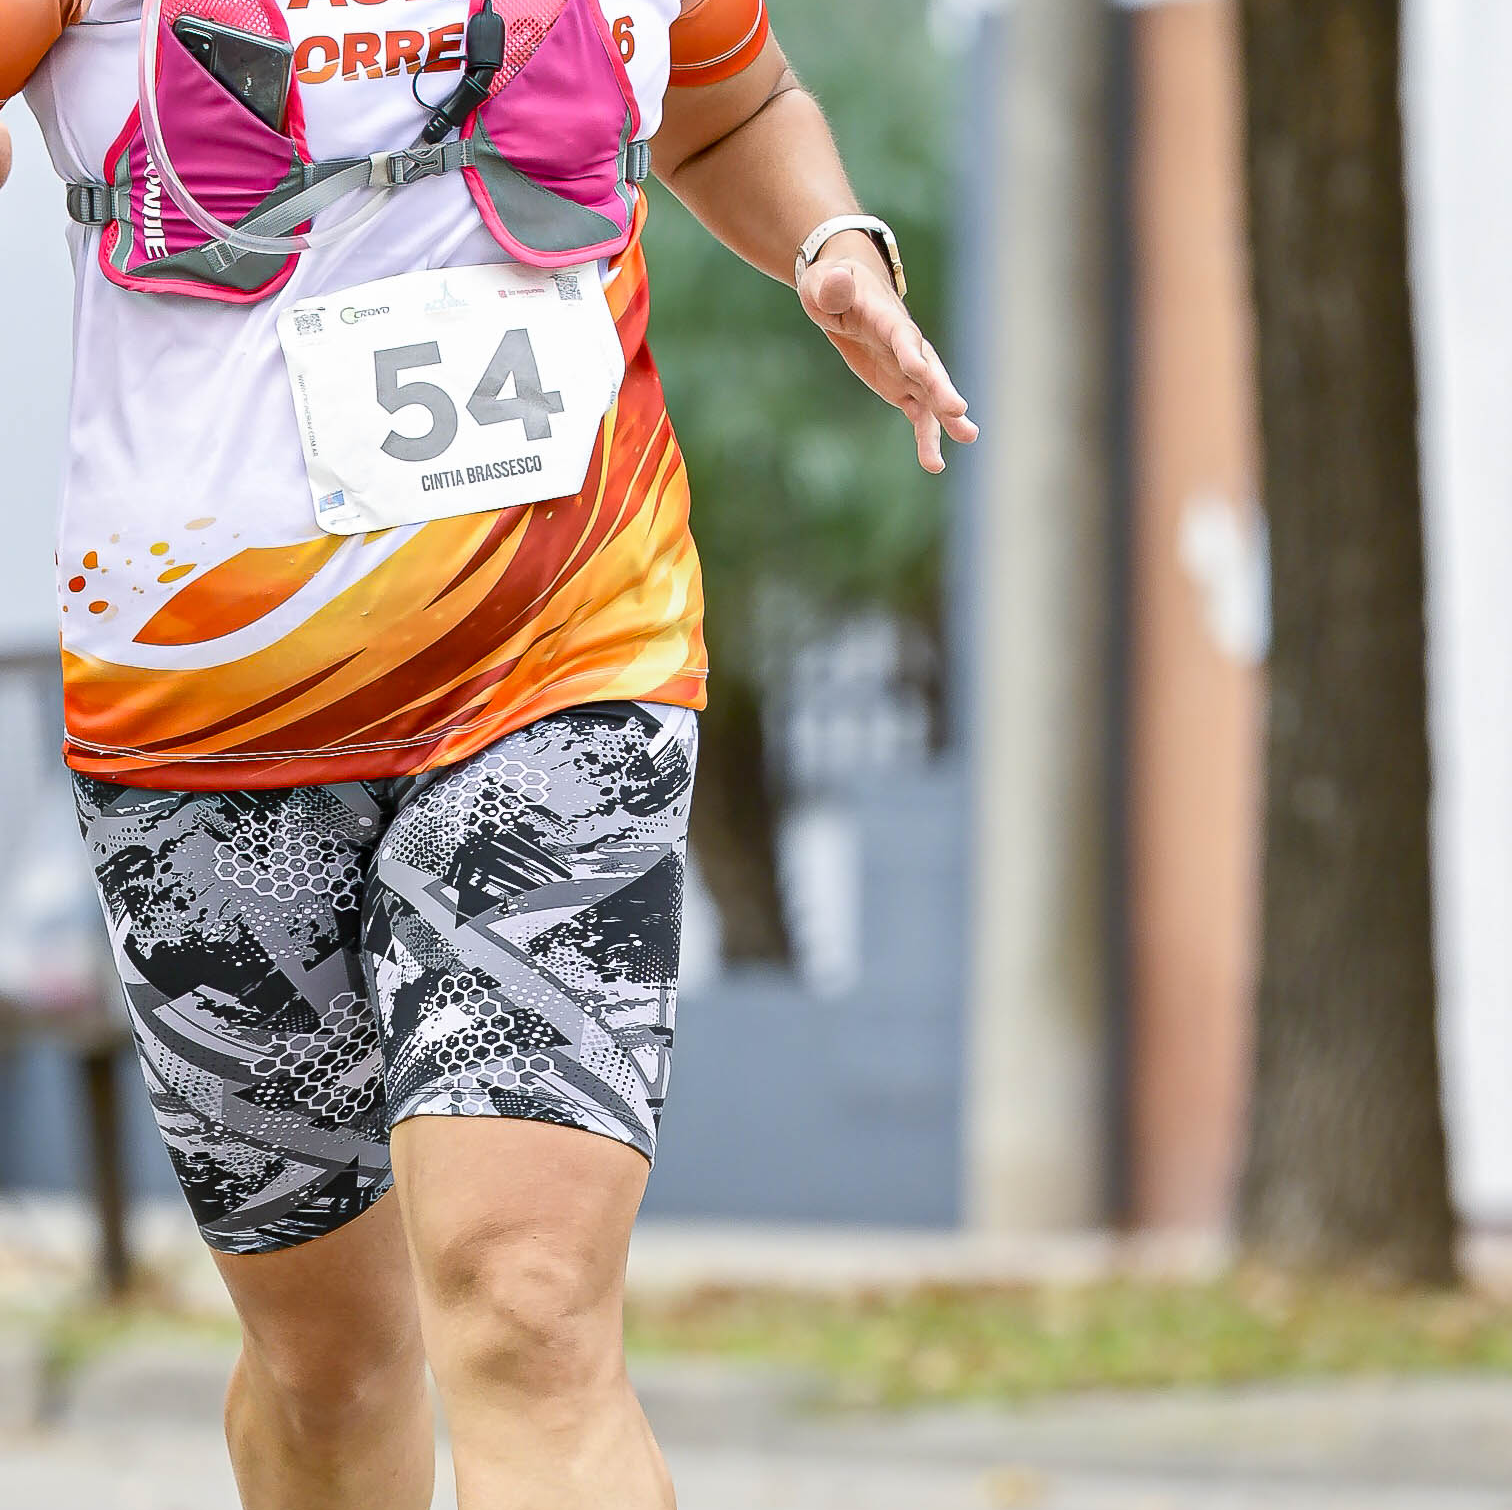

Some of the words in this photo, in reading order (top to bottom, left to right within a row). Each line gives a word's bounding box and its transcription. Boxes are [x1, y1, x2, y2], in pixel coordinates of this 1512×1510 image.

[294, 22, 465, 85] ORRE
[374, 328, 564, 462] 54
[420, 469, 465, 492] CINTIA
[466, 455, 543, 484] BRASSESCO
